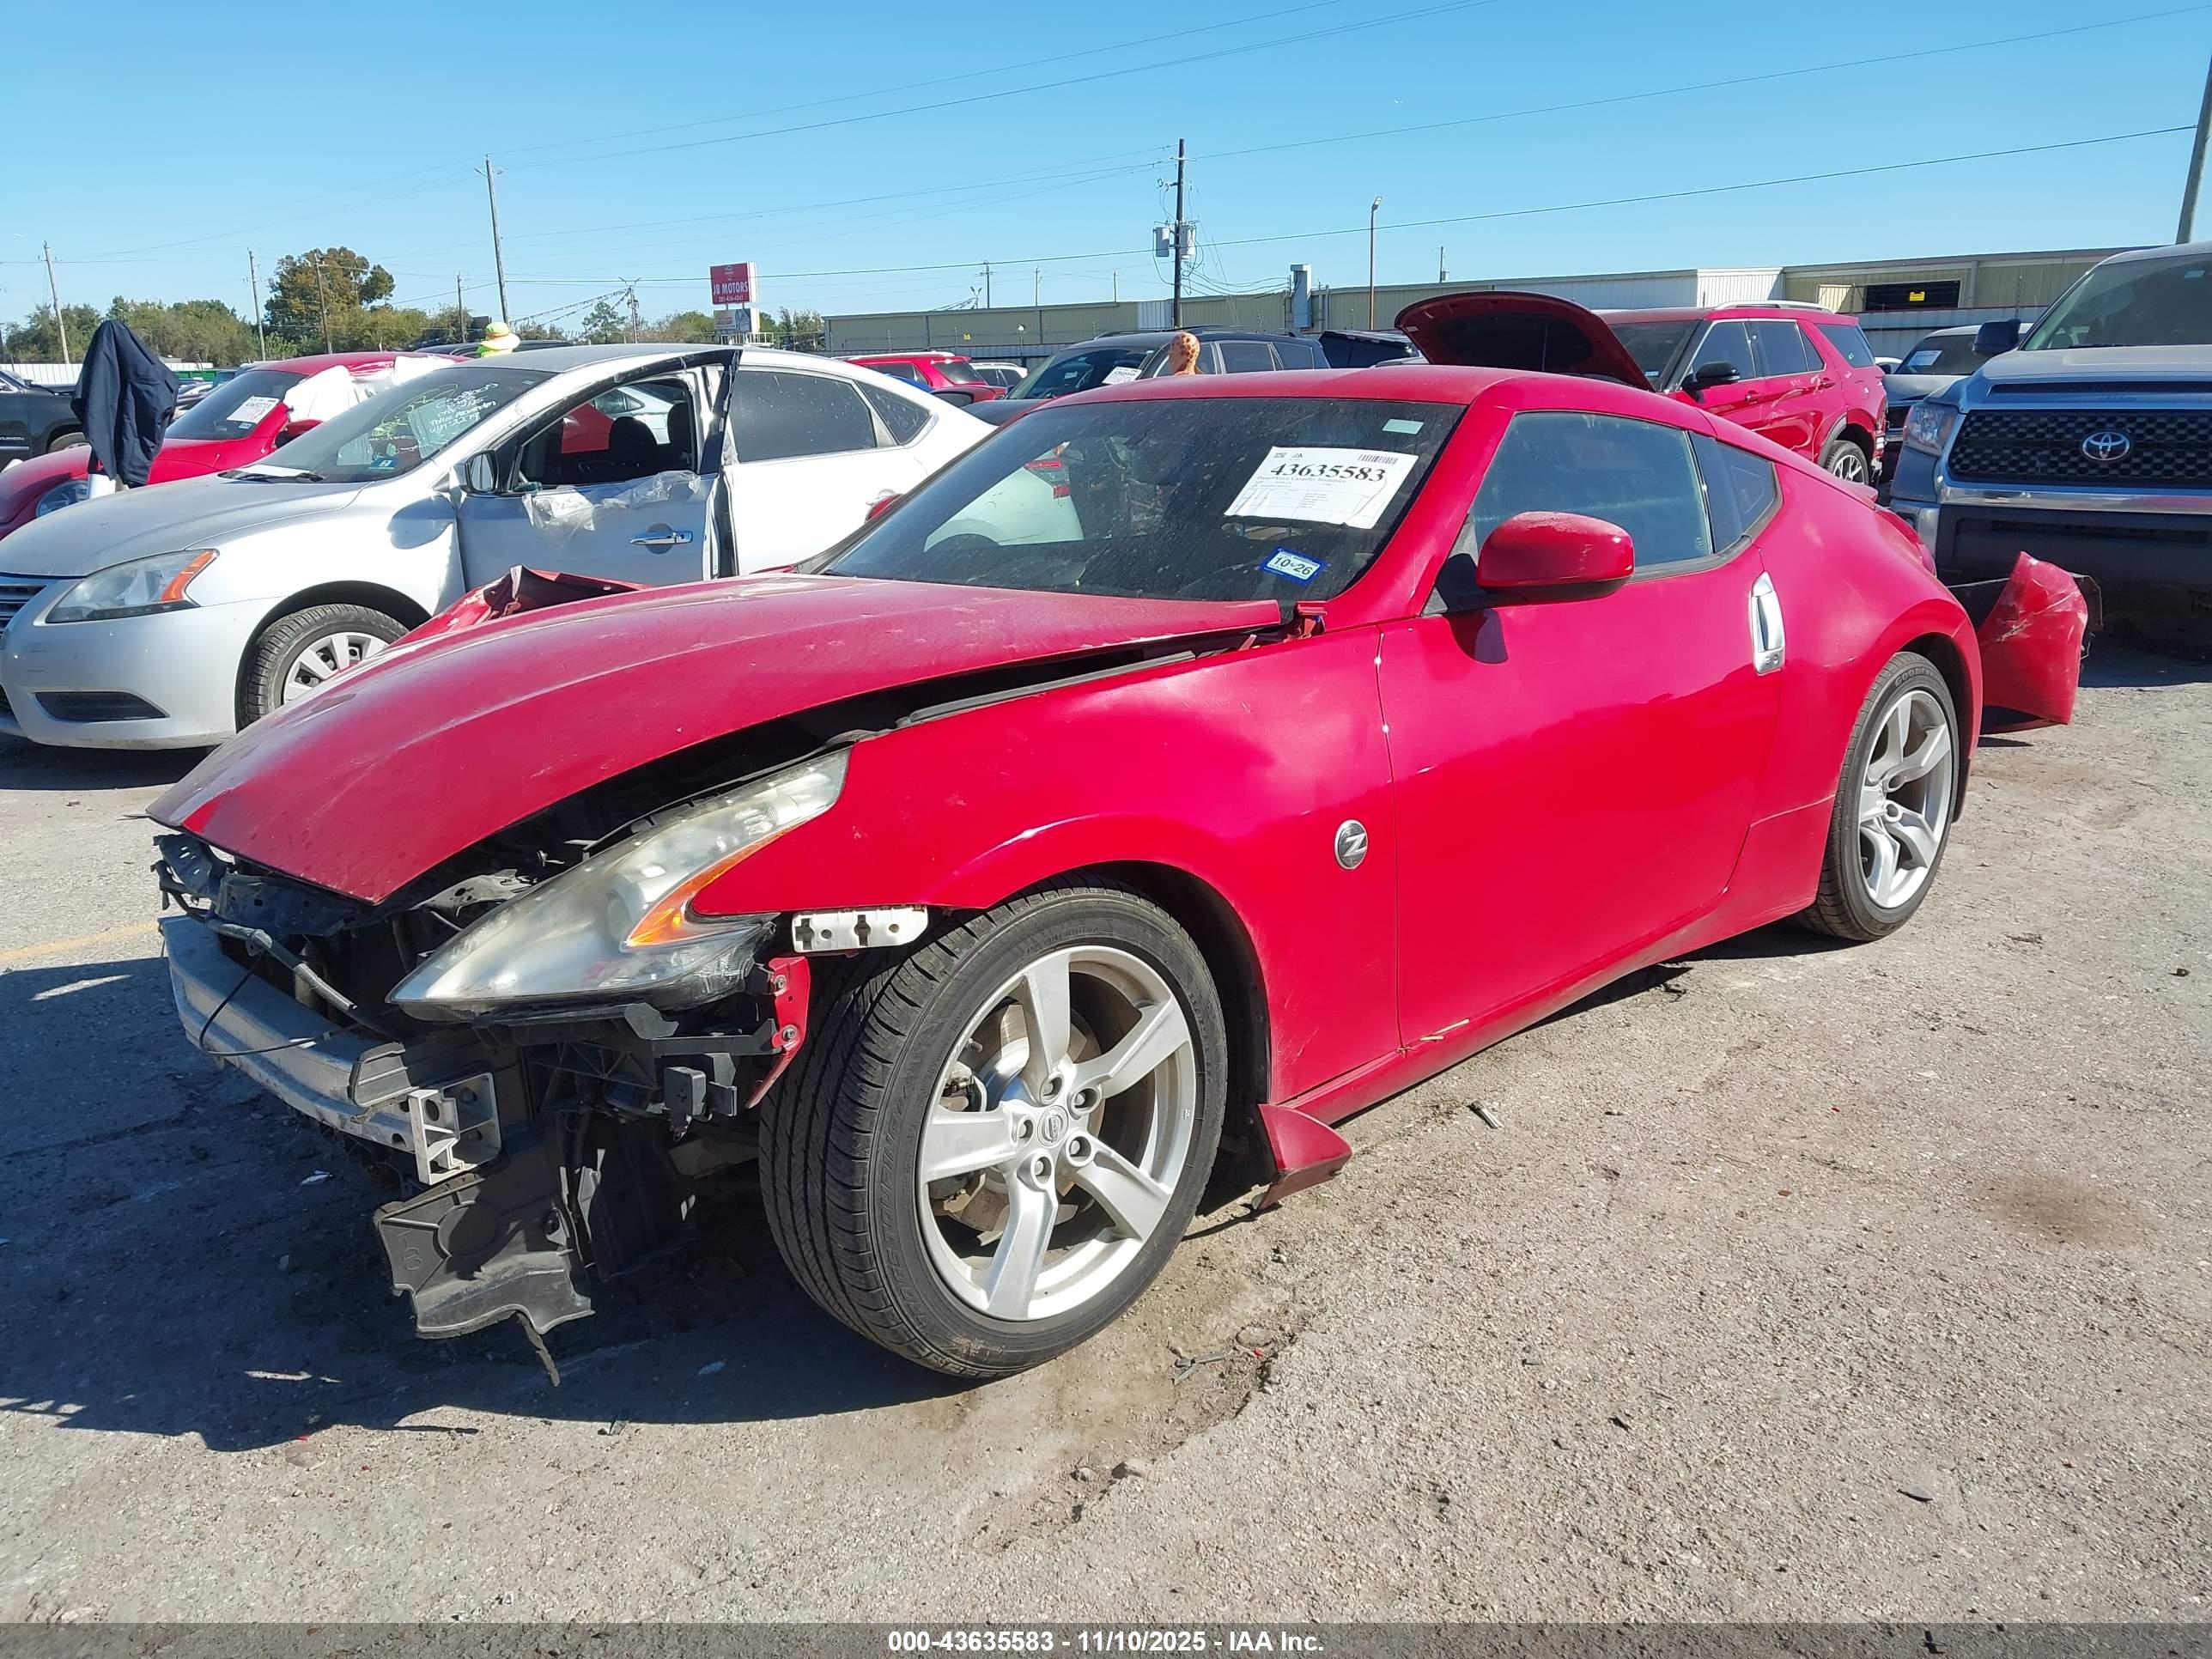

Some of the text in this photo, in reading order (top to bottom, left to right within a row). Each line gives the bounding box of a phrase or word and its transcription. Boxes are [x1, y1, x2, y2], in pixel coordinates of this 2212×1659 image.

[714, 282, 748, 295] JB MOTORS
[1270, 463, 1386, 483] 43635583
[1274, 556, 1313, 575] 10 26
[1342, 832, 1368, 857] Z
